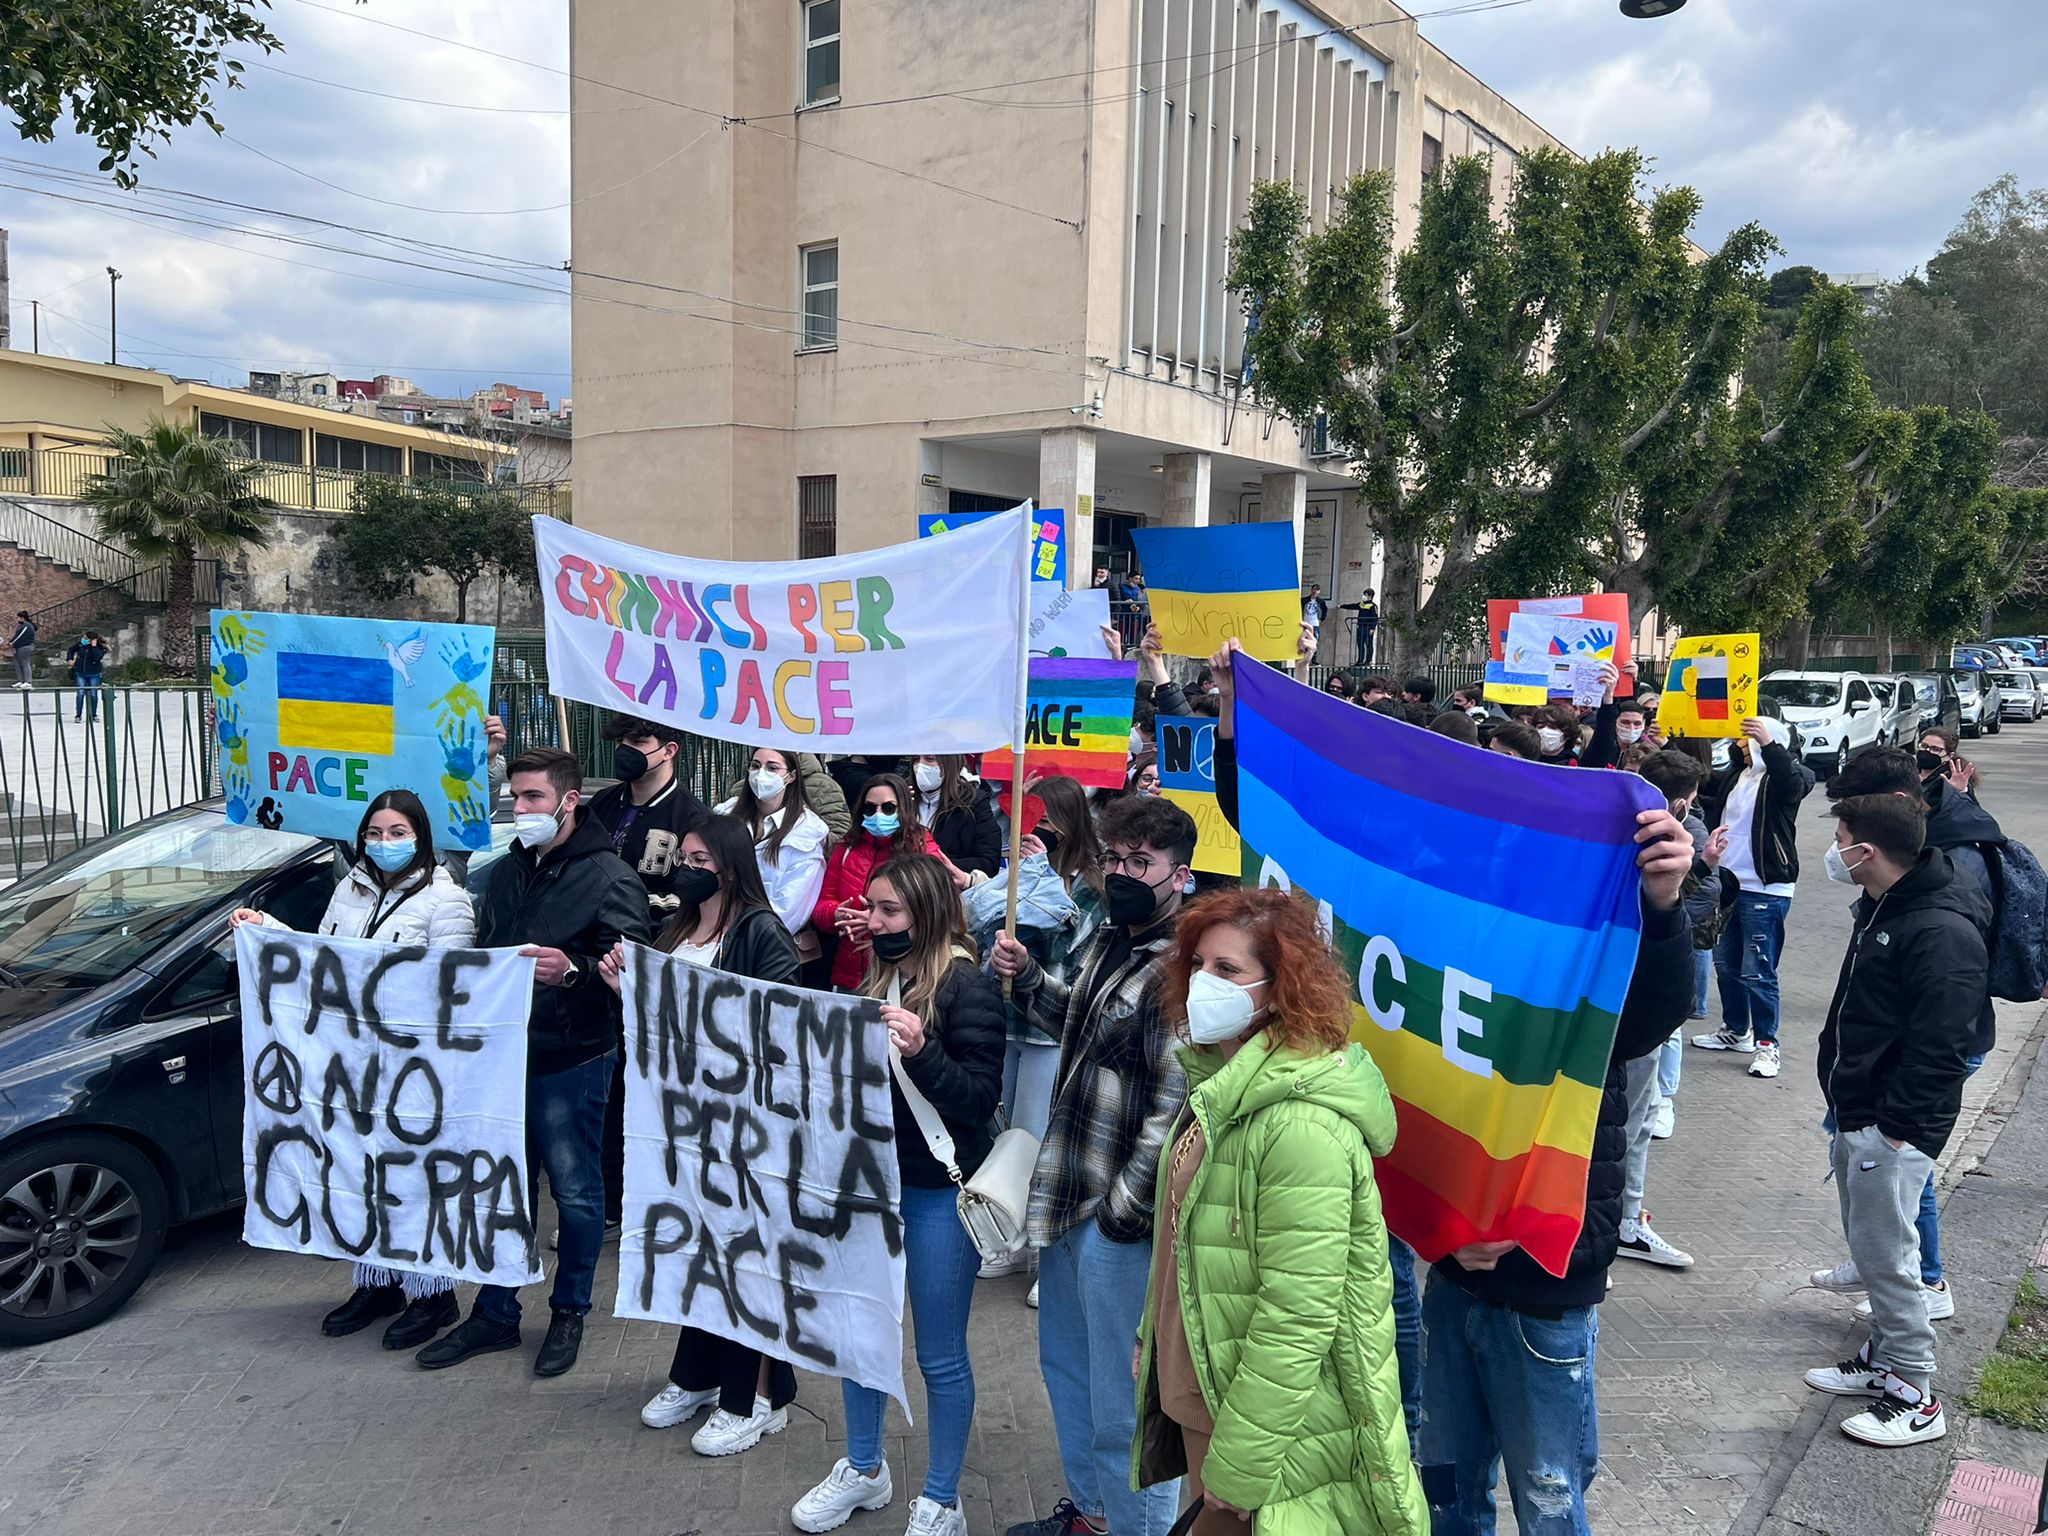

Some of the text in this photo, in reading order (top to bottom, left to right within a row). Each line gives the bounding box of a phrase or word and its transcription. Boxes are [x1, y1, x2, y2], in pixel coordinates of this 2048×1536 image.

[555, 554, 906, 653] CHINNICI PER
[1216, 567, 1257, 589] en
[1029, 618, 1046, 639] NO
[605, 631, 855, 736] LA PACE
[1025, 704, 1083, 747] ACE
[1504, 675, 1531, 684] STOP
[1504, 686, 1522, 694] WAR
[267, 751, 369, 802] PACE
[257, 942, 490, 1052] PACE
[1257, 854, 1493, 1080] CE
[634, 943, 893, 1143] INSIEME
[322, 1053, 444, 1145] NO
[255, 1124, 541, 1274] GUERRA
[662, 1090, 905, 1257] PER LA
[641, 1201, 836, 1367] PACE
